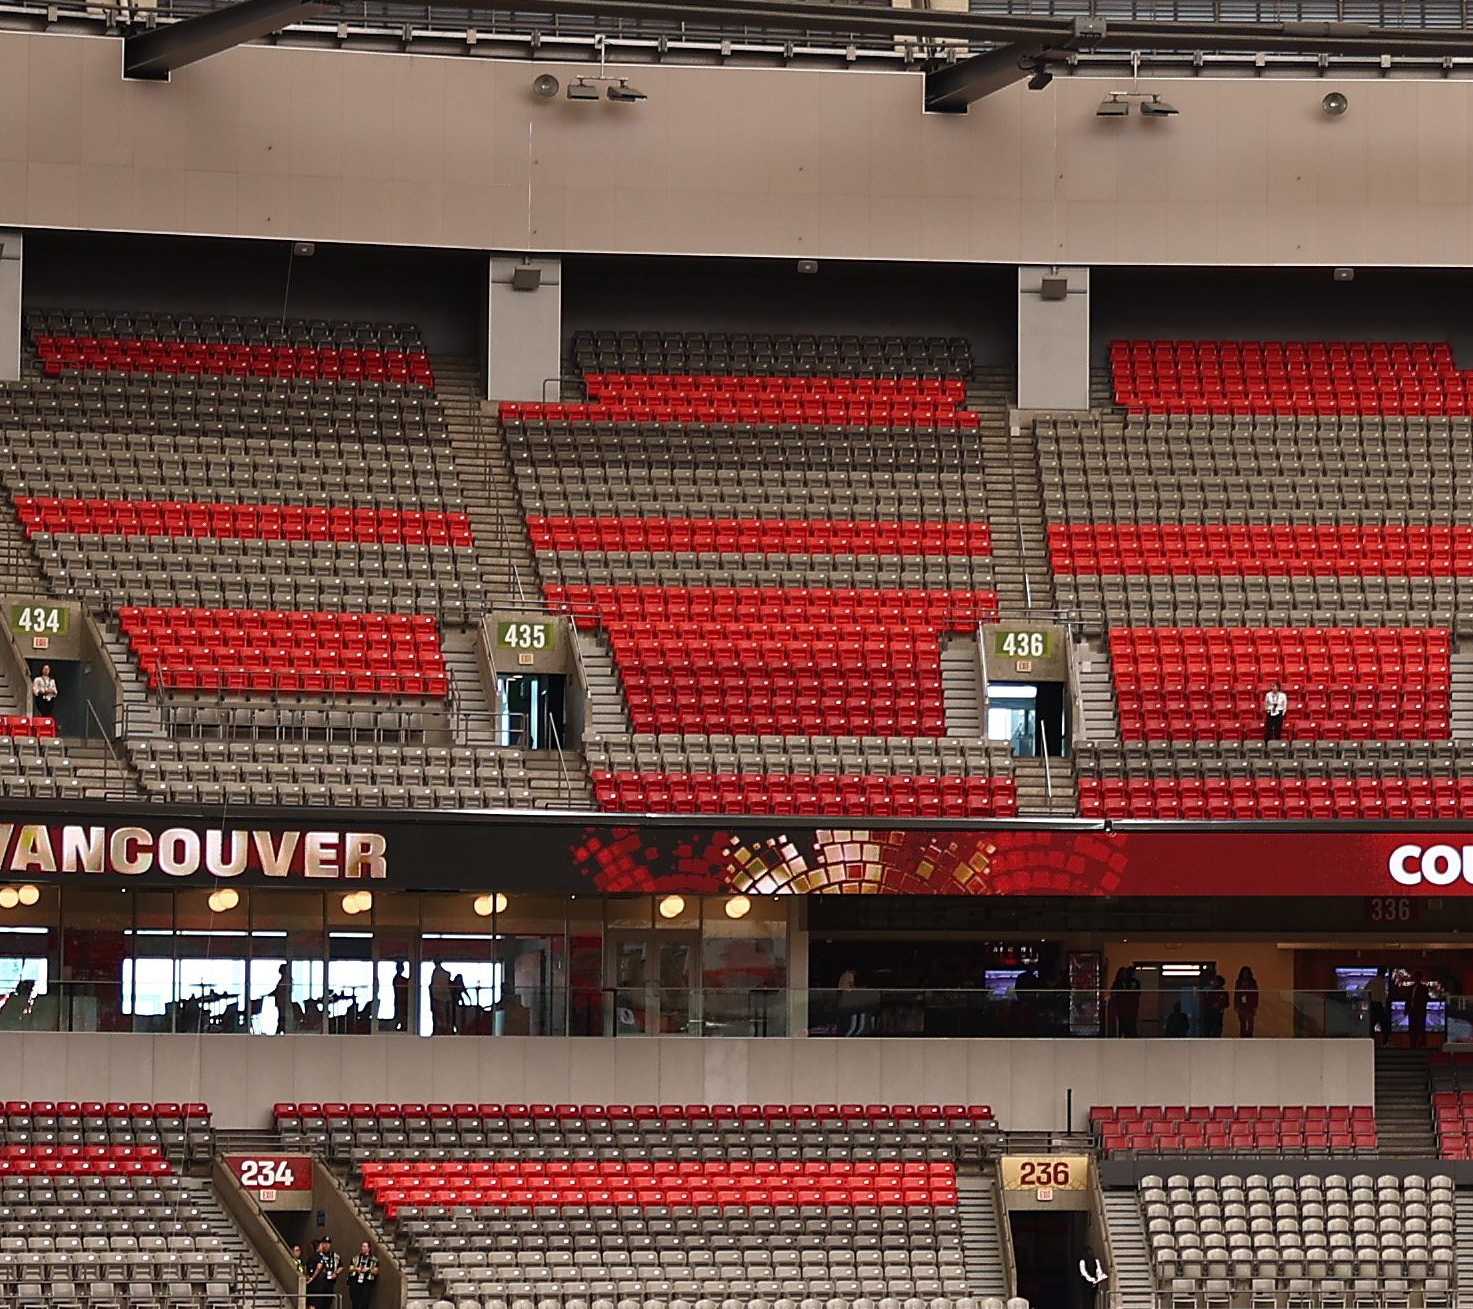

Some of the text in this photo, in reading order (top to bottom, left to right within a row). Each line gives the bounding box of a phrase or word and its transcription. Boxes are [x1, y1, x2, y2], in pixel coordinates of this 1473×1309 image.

[18, 607, 60, 633] 434
[504, 624, 546, 648] 435
[1002, 633, 1043, 656] 436
[1372, 898, 1410, 921] 336
[241, 1160, 294, 1186] 234
[1020, 1161, 1070, 1186] 236
